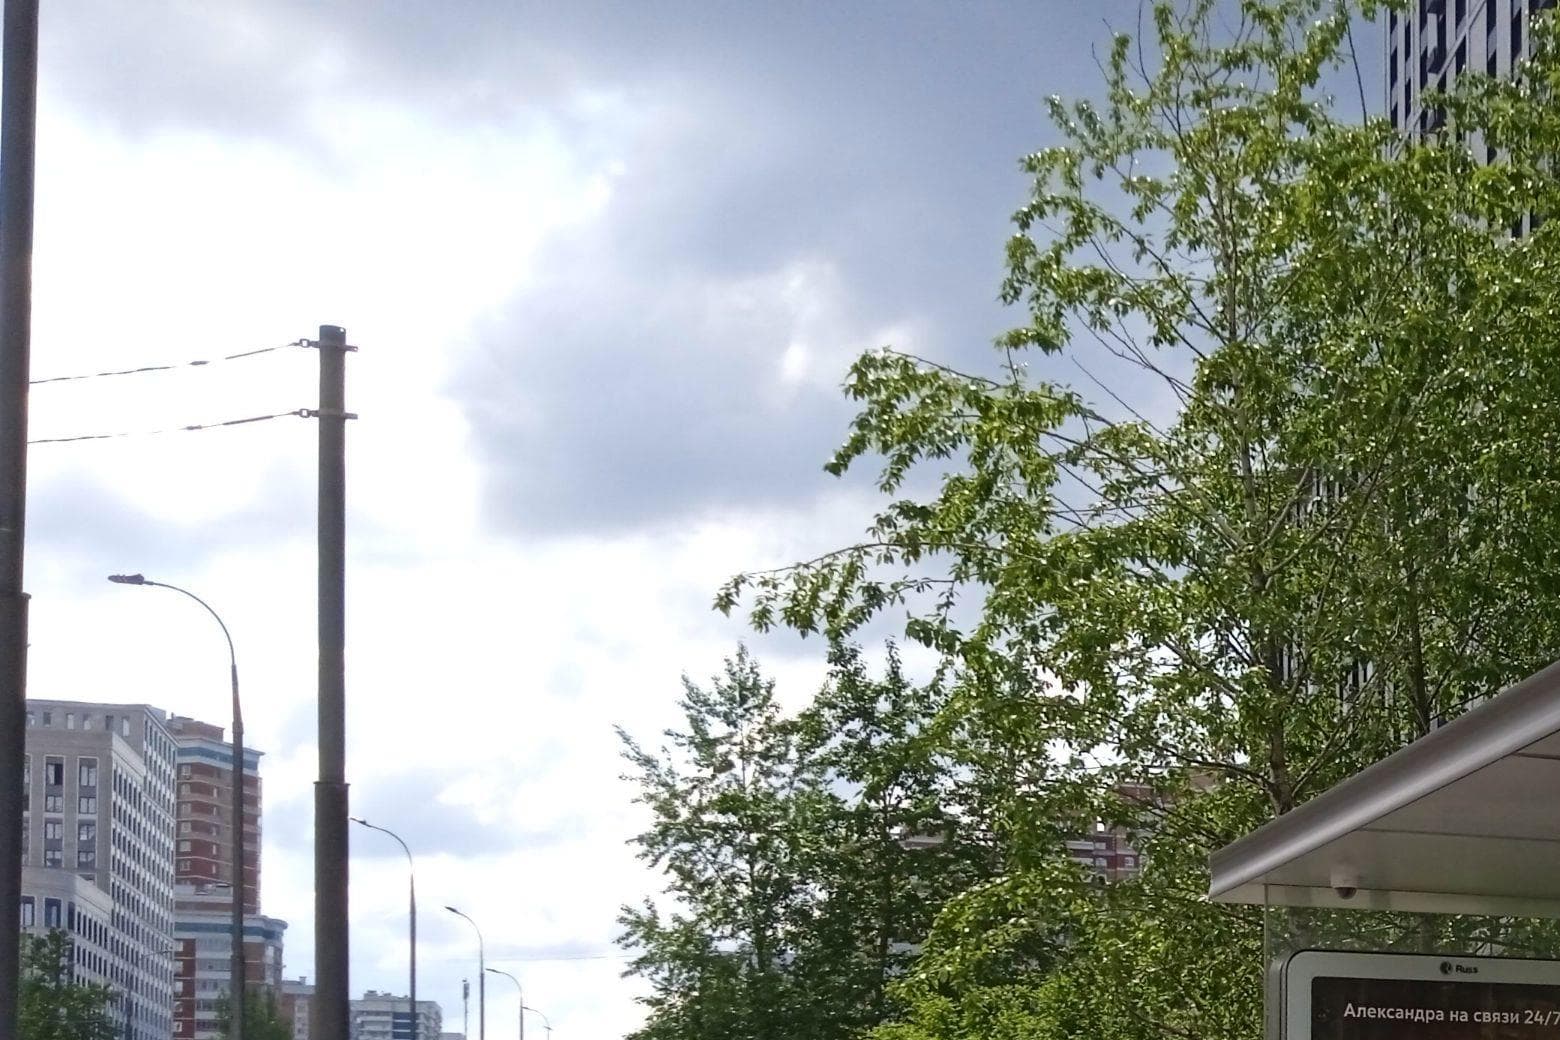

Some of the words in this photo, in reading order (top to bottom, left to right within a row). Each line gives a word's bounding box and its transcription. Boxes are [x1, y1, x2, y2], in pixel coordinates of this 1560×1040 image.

[1455, 964, 1479, 974] Russ
[1343, 1002, 1445, 1024] Александра
[1449, 1010, 1469, 1023] на
[1473, 1010, 1520, 1024] связи
